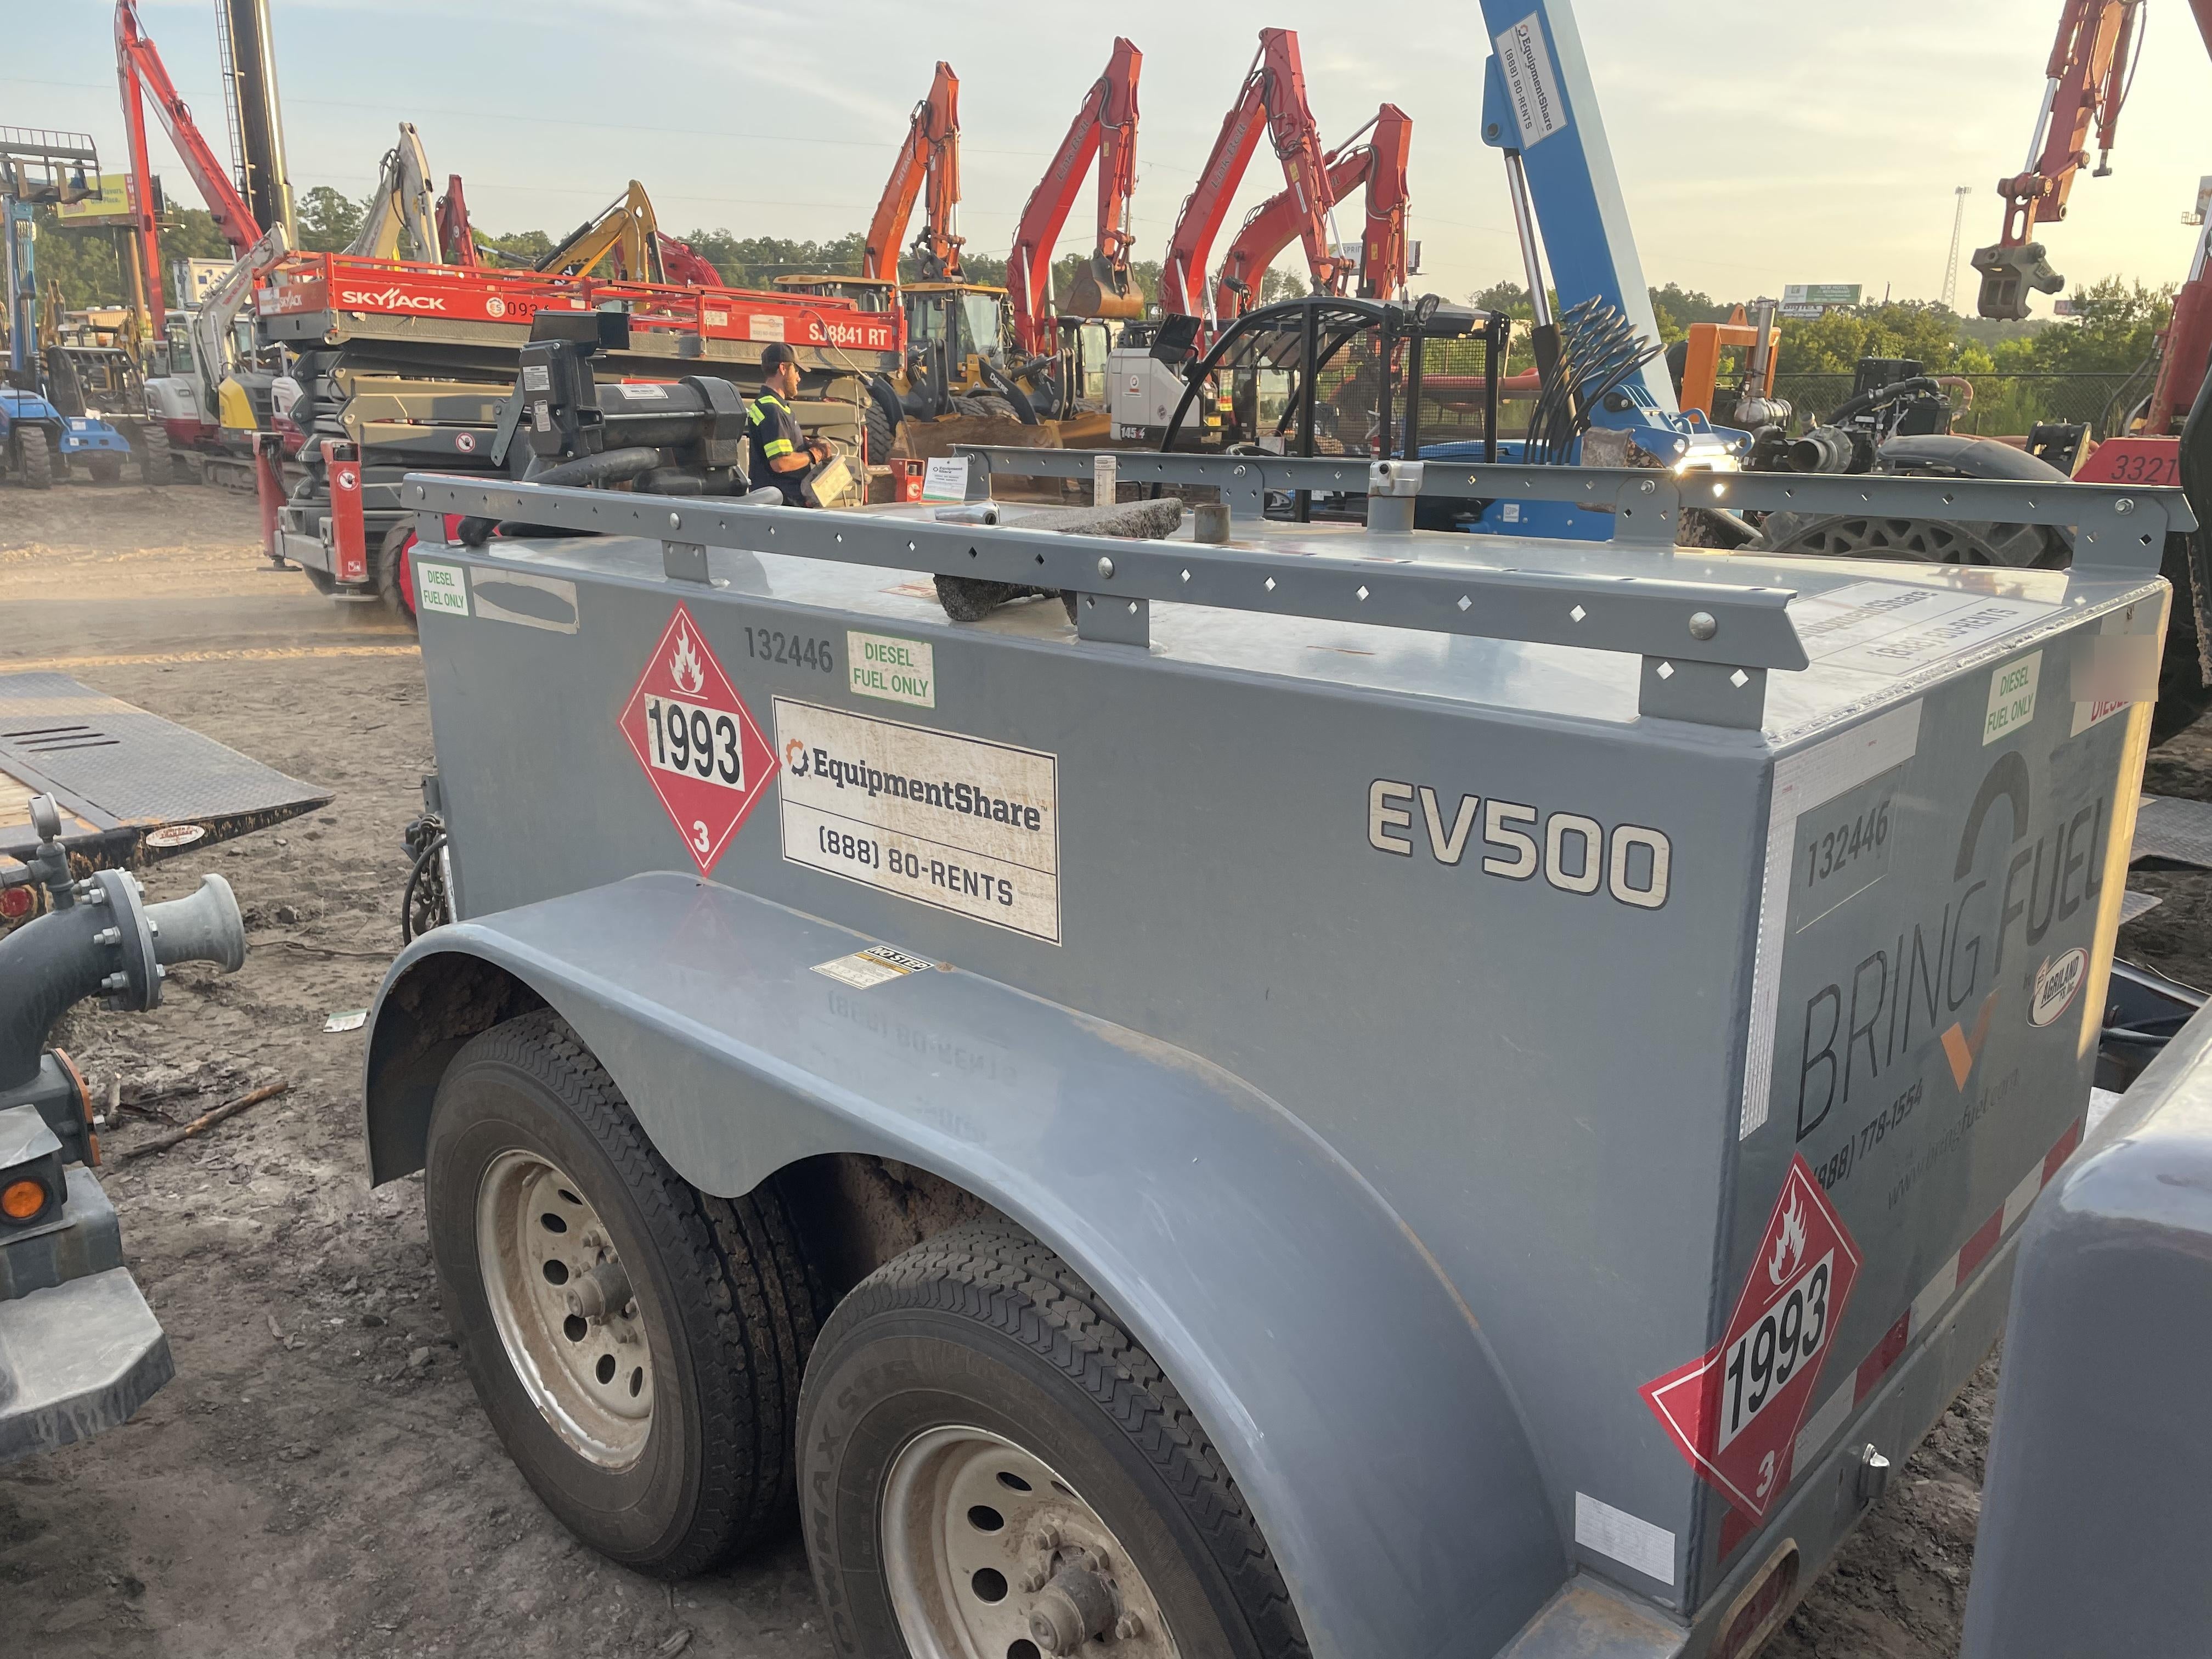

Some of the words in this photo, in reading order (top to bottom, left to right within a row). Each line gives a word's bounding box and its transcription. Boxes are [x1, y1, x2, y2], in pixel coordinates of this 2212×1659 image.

[1505, 48, 1519, 78] (888)
[1514, 80, 1532, 129] 80-RENTS
[1522, 36, 1553, 131] EquipmentShare
[1056, 120, 1090, 181] Link-Belt
[1211, 123, 1246, 189] Link-Belt
[342, 287, 446, 311] SKYJACK
[809, 323, 863, 345] SJ8841
[868, 328, 888, 346] RT
[990, 373, 1009, 395] DEERE
[2111, 455, 2177, 483] 3321
[423, 589, 443, 606] FUEL
[444, 592, 464, 609] ONLY
[427, 569, 455, 586] DIESEL
[1923, 607, 2020, 639] 80-RENTS
[744, 627, 834, 674] 132446
[864, 641, 915, 667] DIESEL
[853, 668, 888, 691] FUEL
[890, 674, 929, 698] ONLY
[1999, 665, 2029, 697] DIESEL
[1986, 706, 2009, 735] FUEL
[2011, 692, 2035, 720] ONLY
[647, 699, 741, 785] 1993
[812, 747, 1041, 832] EquipmentShare
[692, 820, 710, 854] 3
[1367, 777, 1674, 911] EV500
[1808, 800, 1891, 888] 132446
[819, 825, 879, 869] (888)
[888, 848, 1014, 907] 80-RENTS
[870, 946, 891, 958] NO
[891, 953, 928, 970] STEP
[1795, 878, 1987, 1144] BRING
[1993, 795, 2103, 977] FUEL
[2041, 955, 2080, 1005] AGRILAND
[1860, 1077, 1923, 1160] 778-1554
[1726, 1262, 1829, 1435] 1993
[1756, 1449, 1776, 1498] 3
